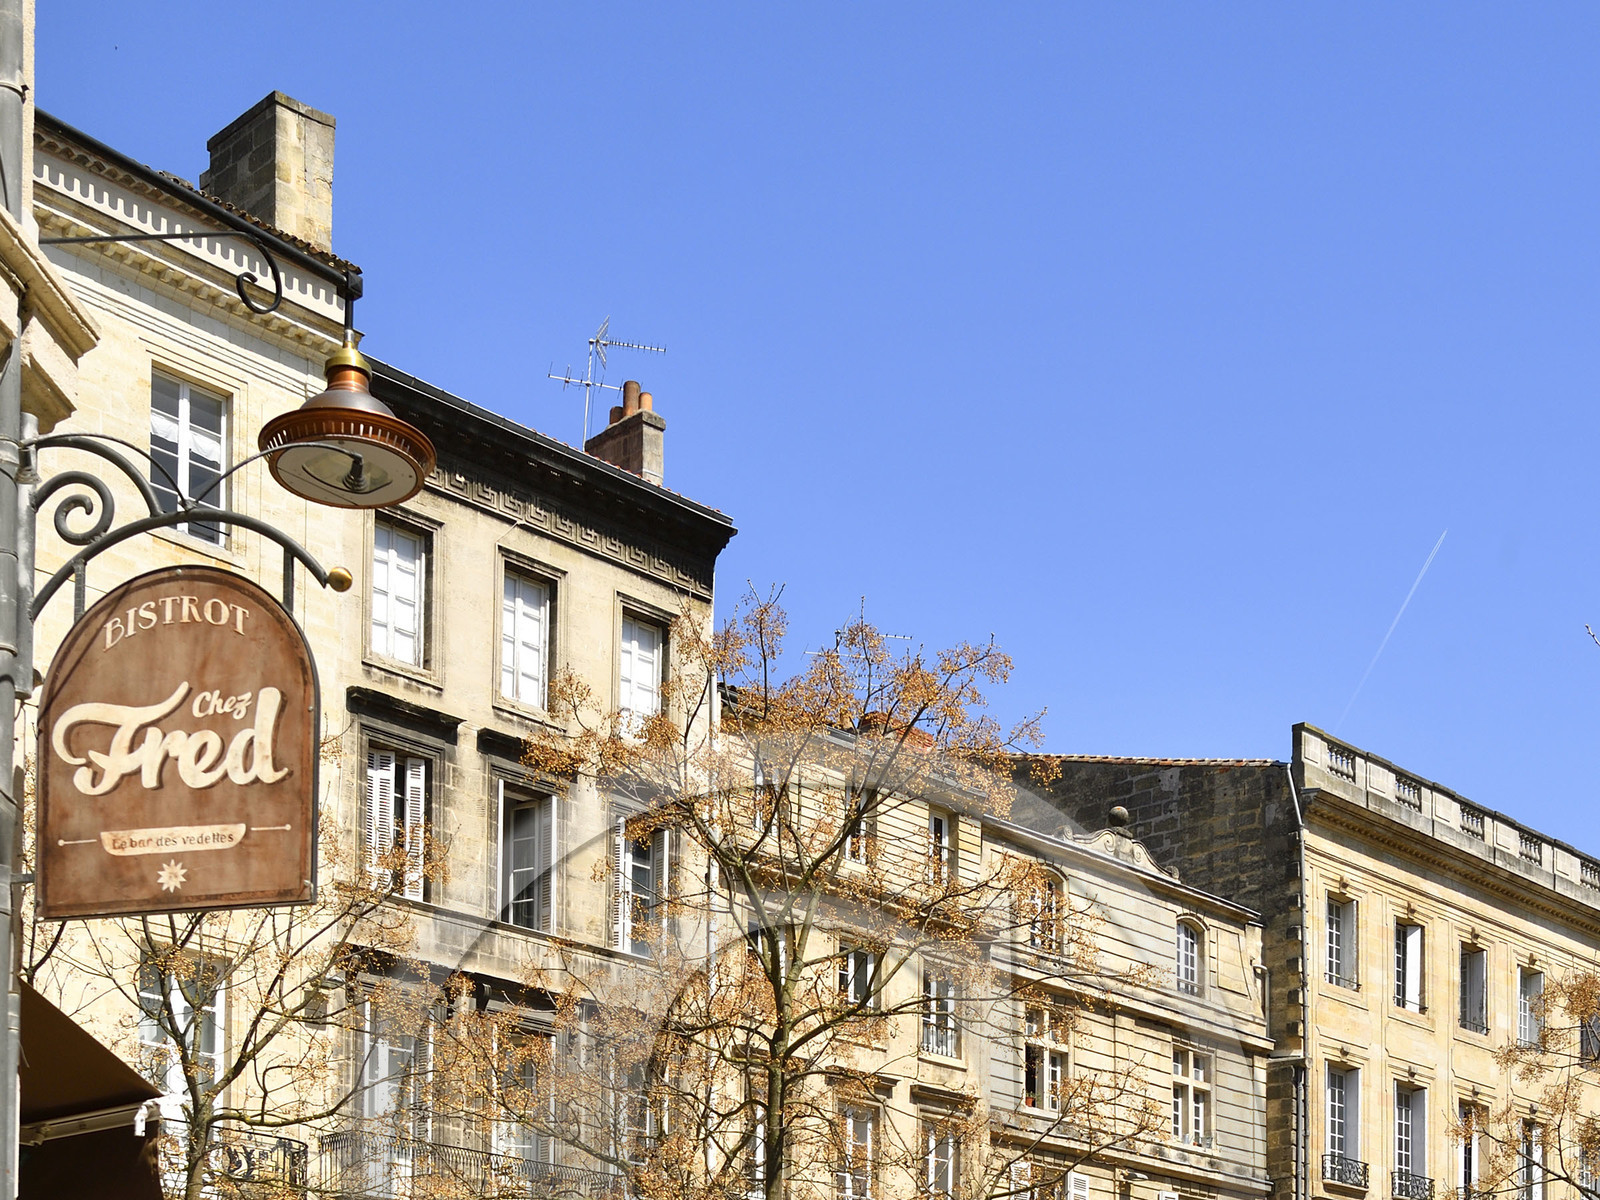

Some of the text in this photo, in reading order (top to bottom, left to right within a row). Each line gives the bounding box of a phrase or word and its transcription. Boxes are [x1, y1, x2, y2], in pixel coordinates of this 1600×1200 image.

[102, 595, 250, 652] BISTROT
[192, 690, 253, 720] Chez
[52, 681, 290, 796] Fred
[111, 832, 234, 850] Le bar des vedettes
